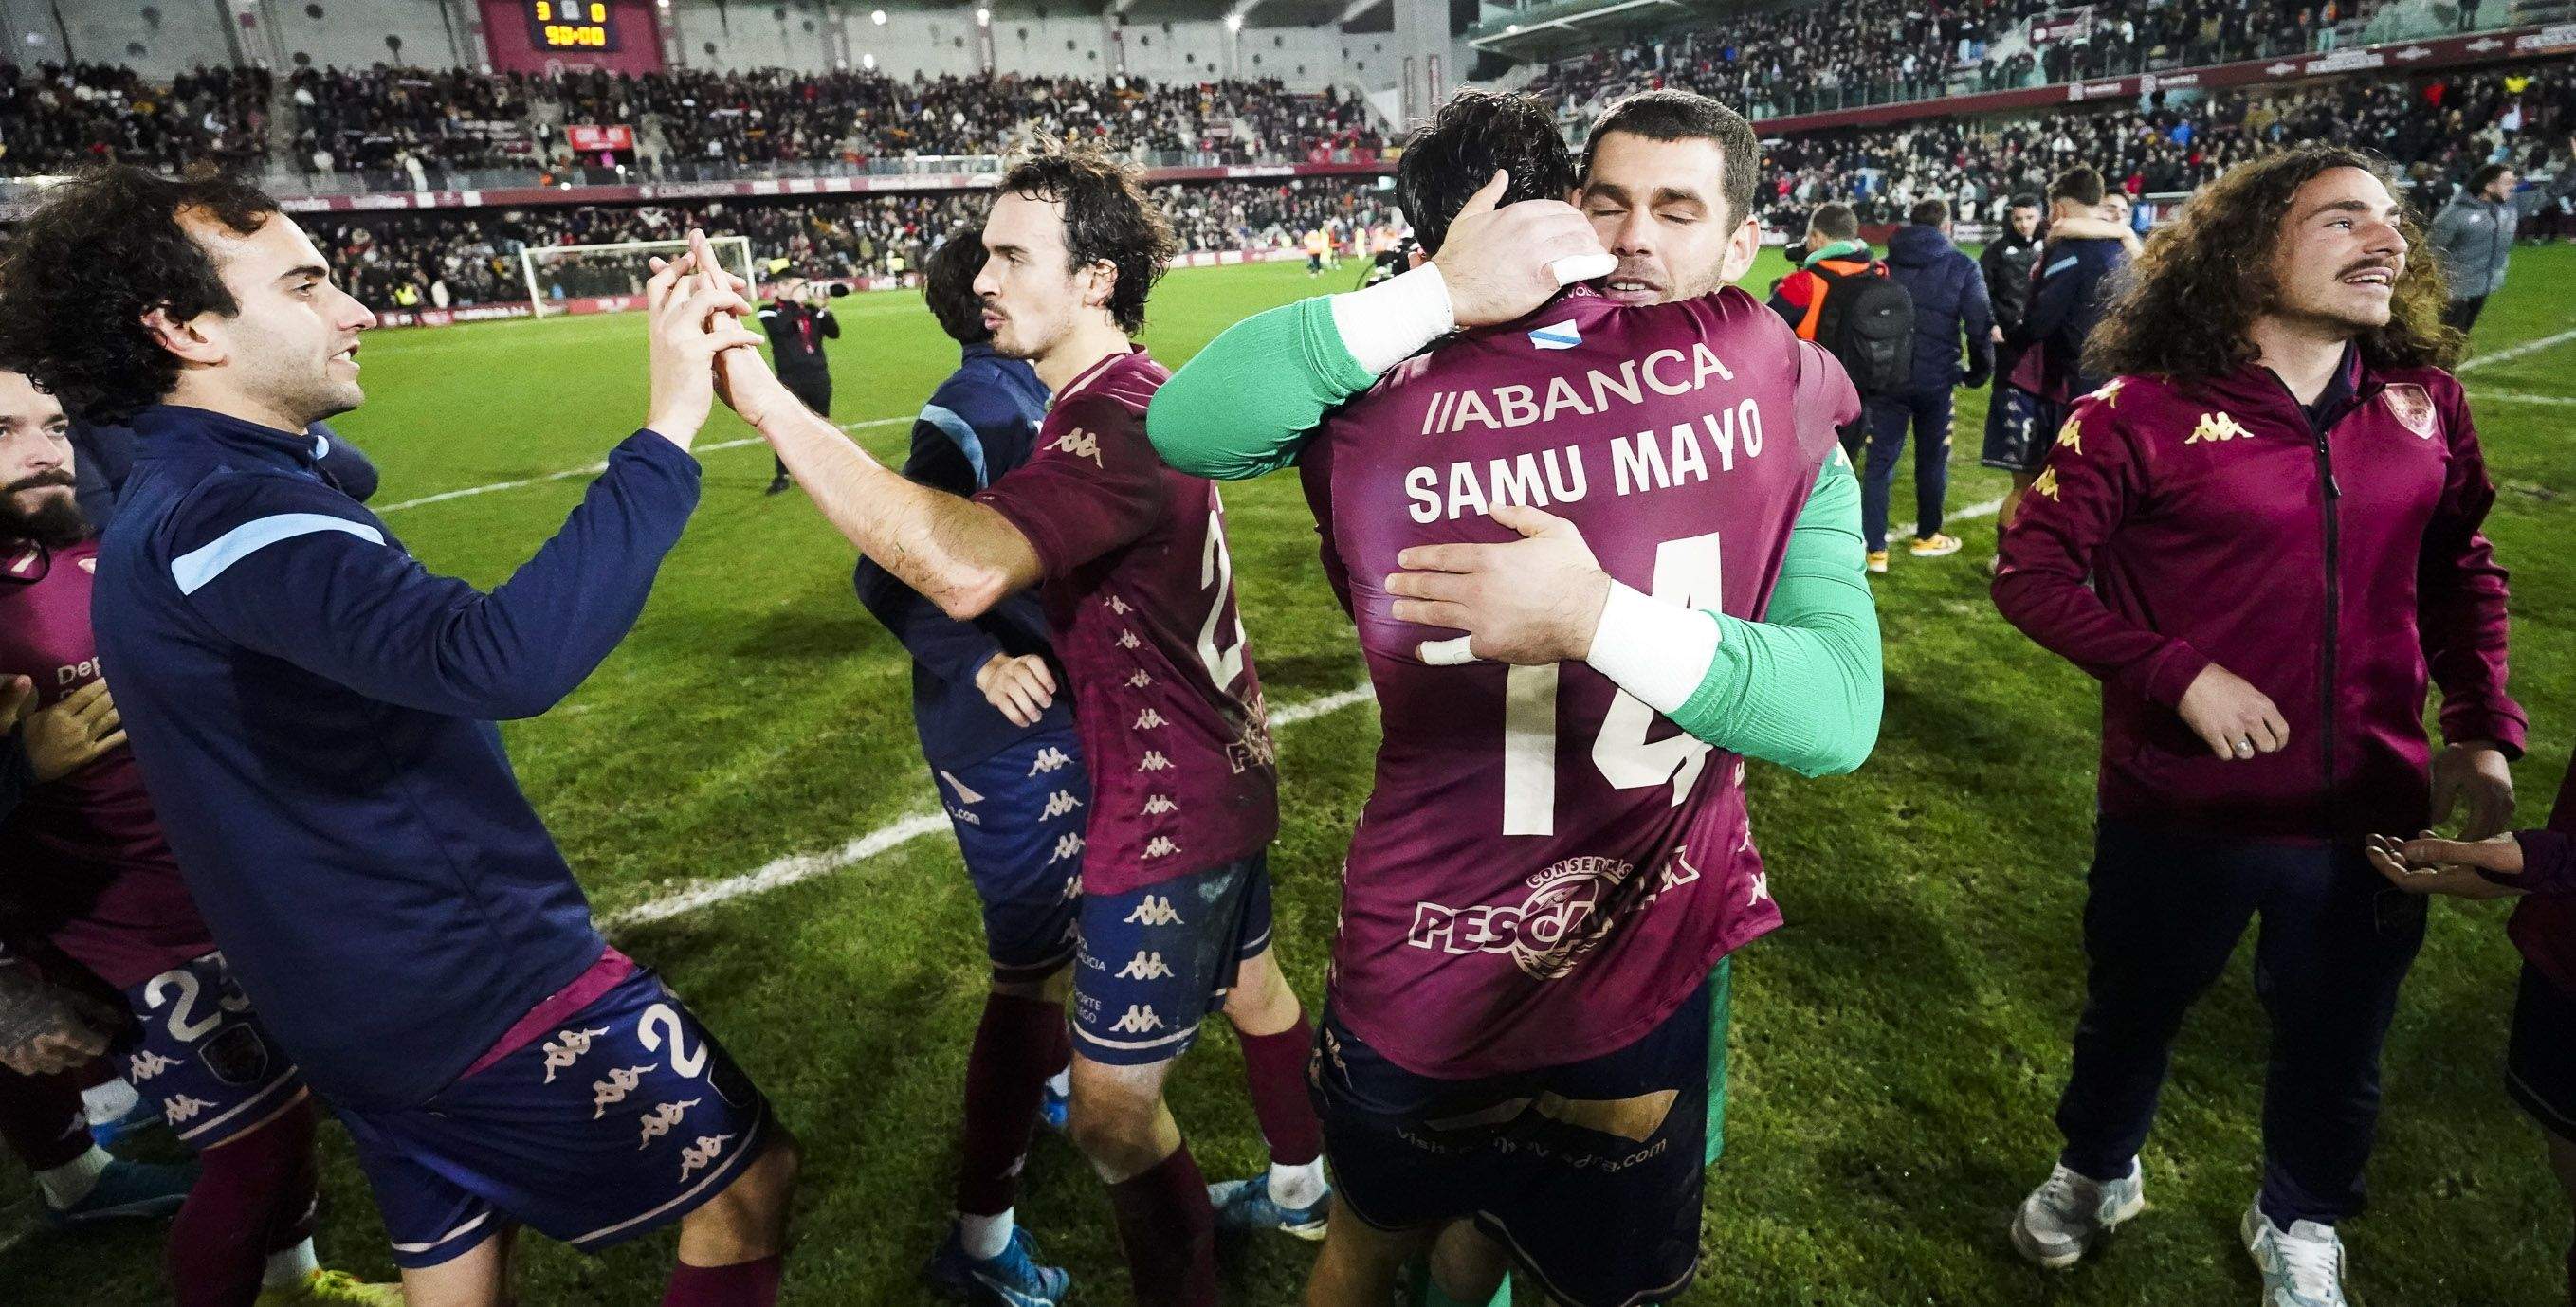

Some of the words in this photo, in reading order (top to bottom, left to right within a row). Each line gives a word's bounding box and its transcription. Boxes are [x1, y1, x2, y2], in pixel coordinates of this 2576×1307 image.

[536, 1, 551, 21] 3
[591, 3, 606, 23] 0
[1405, 445, 1589, 524] SAMU
[1610, 398, 1763, 496] MAYO
